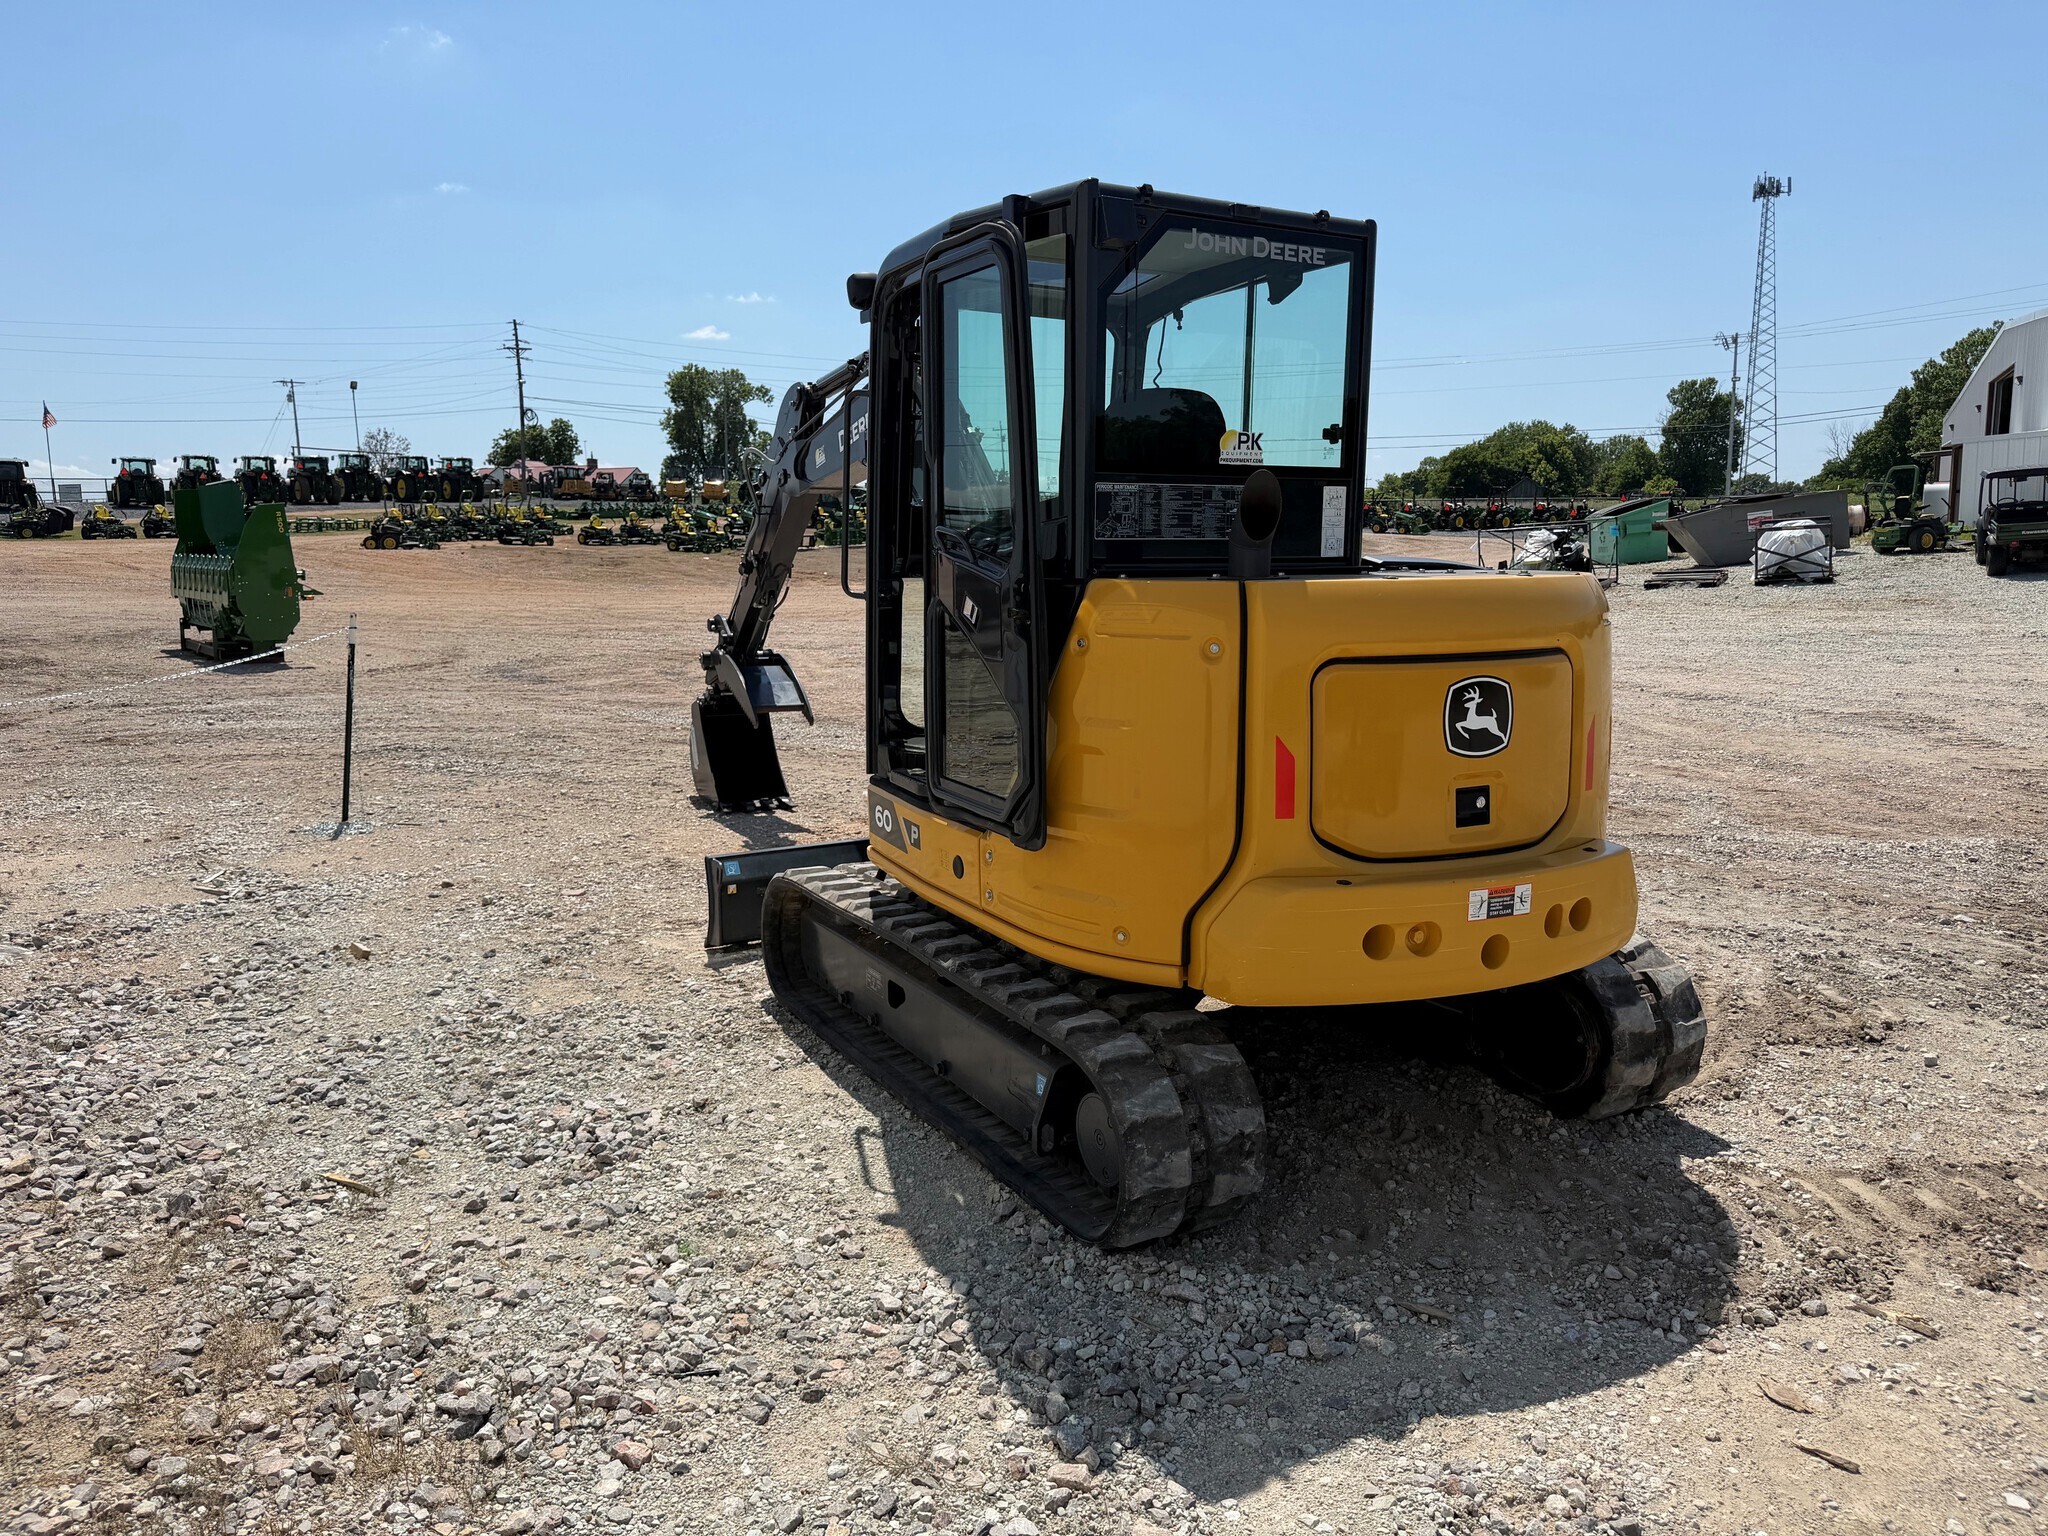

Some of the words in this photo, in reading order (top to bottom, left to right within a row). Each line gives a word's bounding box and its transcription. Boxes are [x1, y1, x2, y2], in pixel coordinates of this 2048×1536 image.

[1183, 228, 1247, 256] JOHN
[1253, 236, 1326, 265] DEERE
[874, 804, 892, 833] 60
[910, 825, 919, 844] P
[1493, 887, 1515, 895] WARNING
